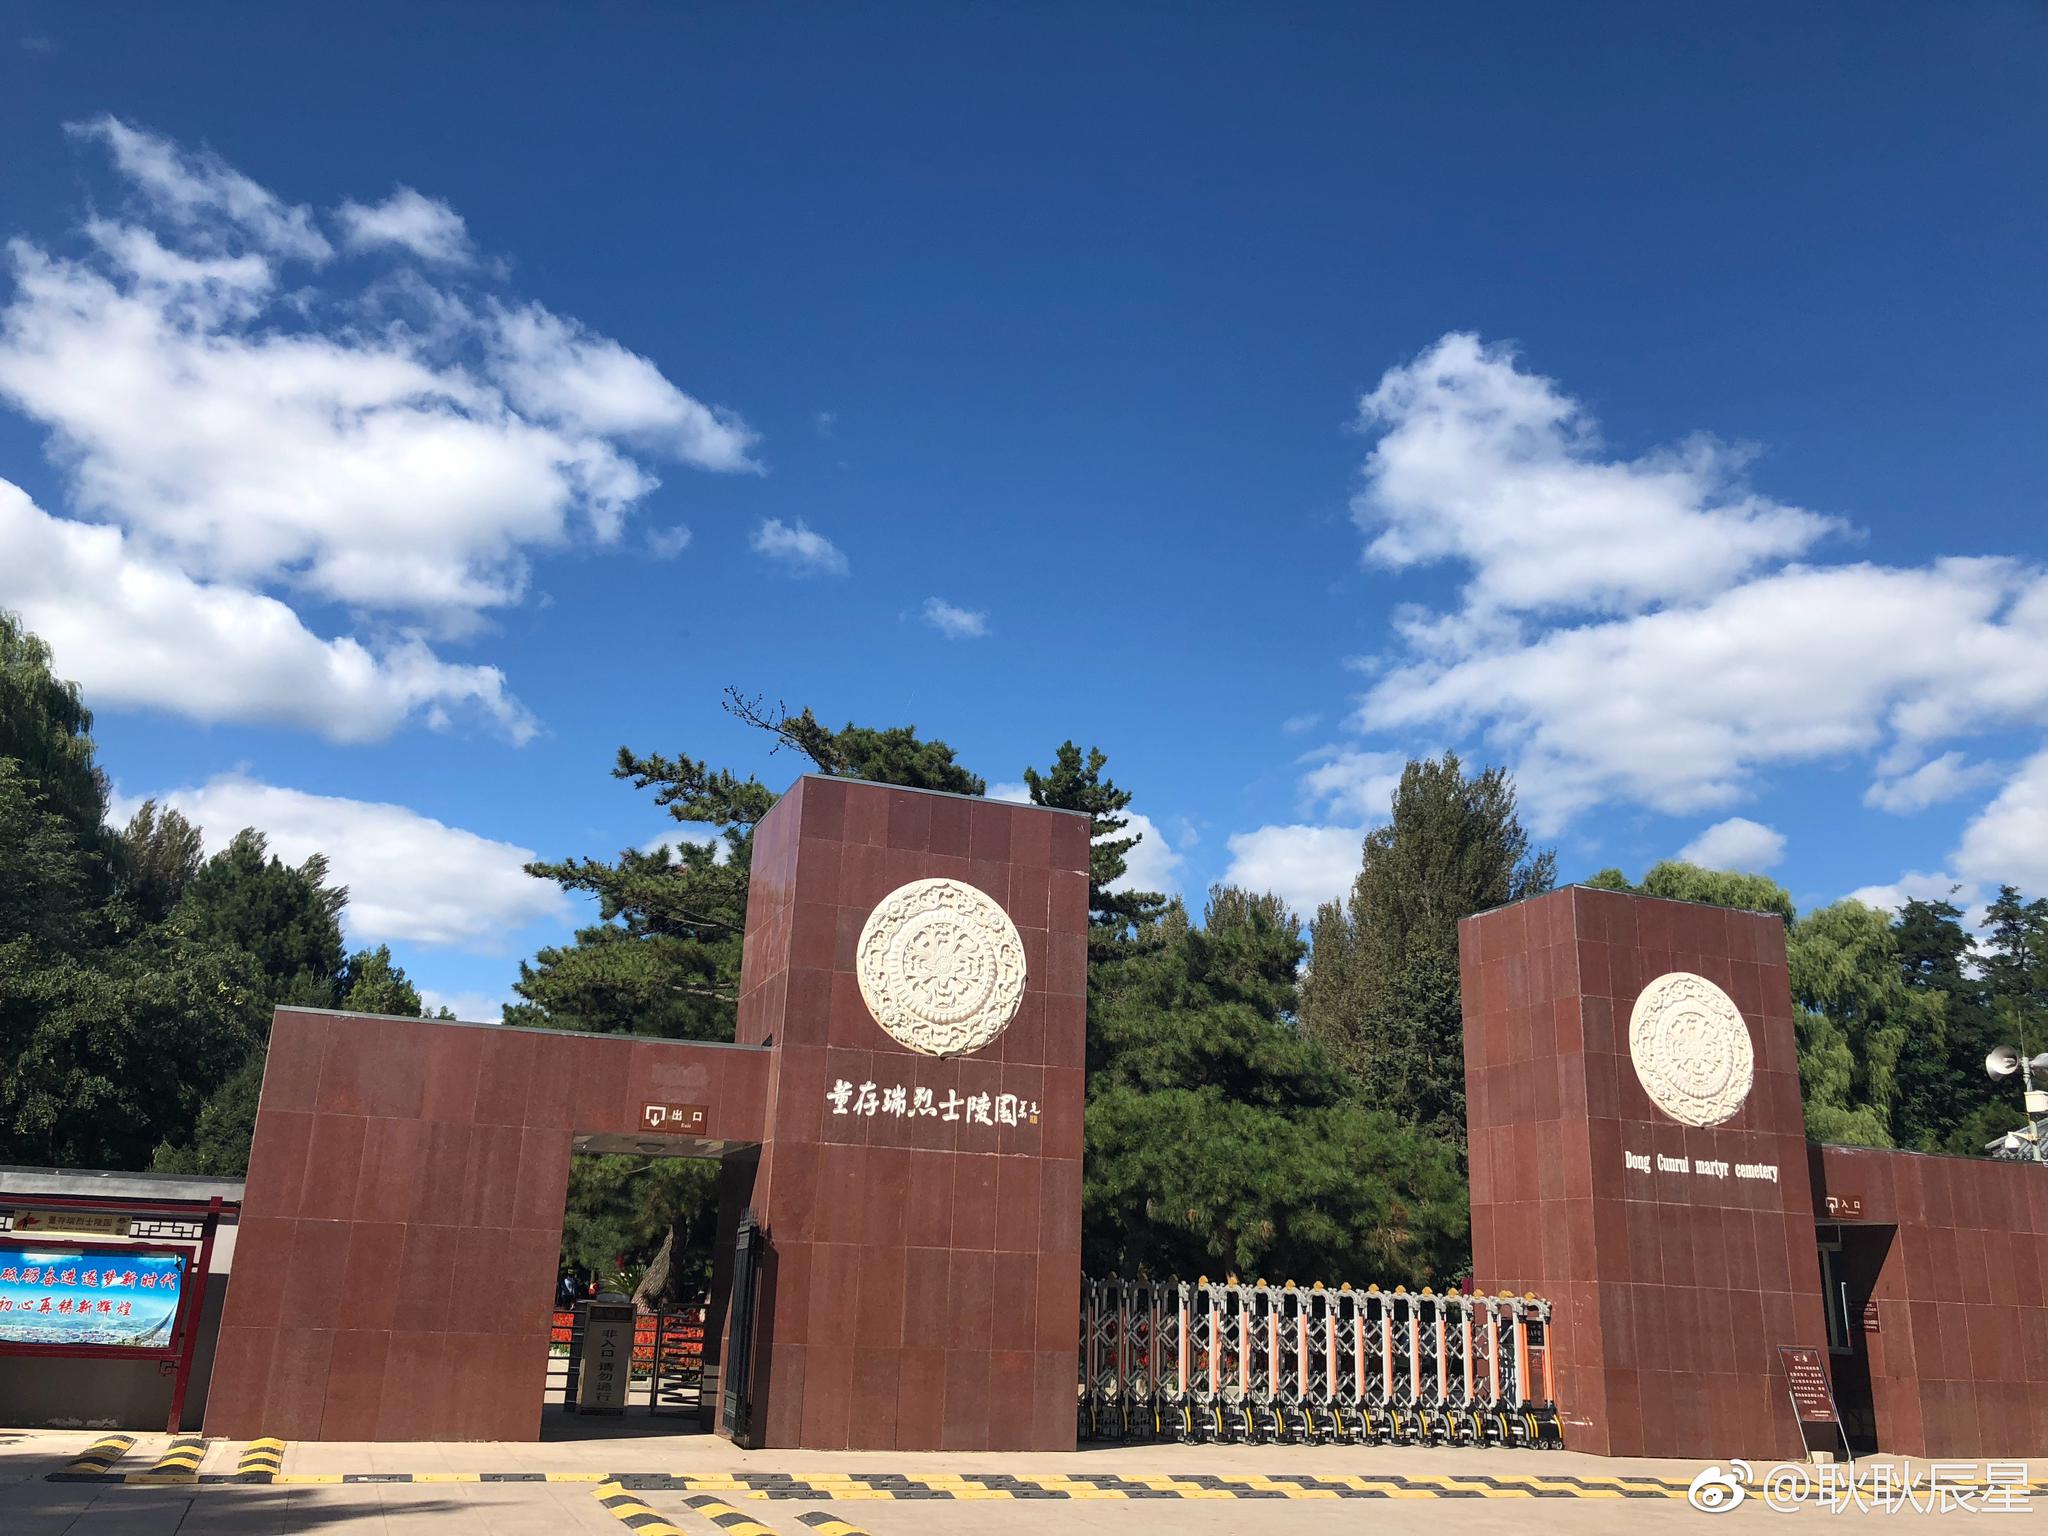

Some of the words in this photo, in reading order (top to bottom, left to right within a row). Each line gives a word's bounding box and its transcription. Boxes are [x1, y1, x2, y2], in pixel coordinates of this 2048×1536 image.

[671, 1108, 703, 1122] 出口
[1625, 1150, 1651, 1173] Dong
[1657, 1150, 1690, 1173] Cunrui
[1695, 1159, 1729, 1179] martyr
[1735, 1162, 1778, 1183] cemetery
[1841, 1199, 1861, 1209] 入口
[0, 1266, 178, 1290] 砥砺奋进逐梦新时代
[0, 1296, 132, 1317] 初心再铸新辉煌
